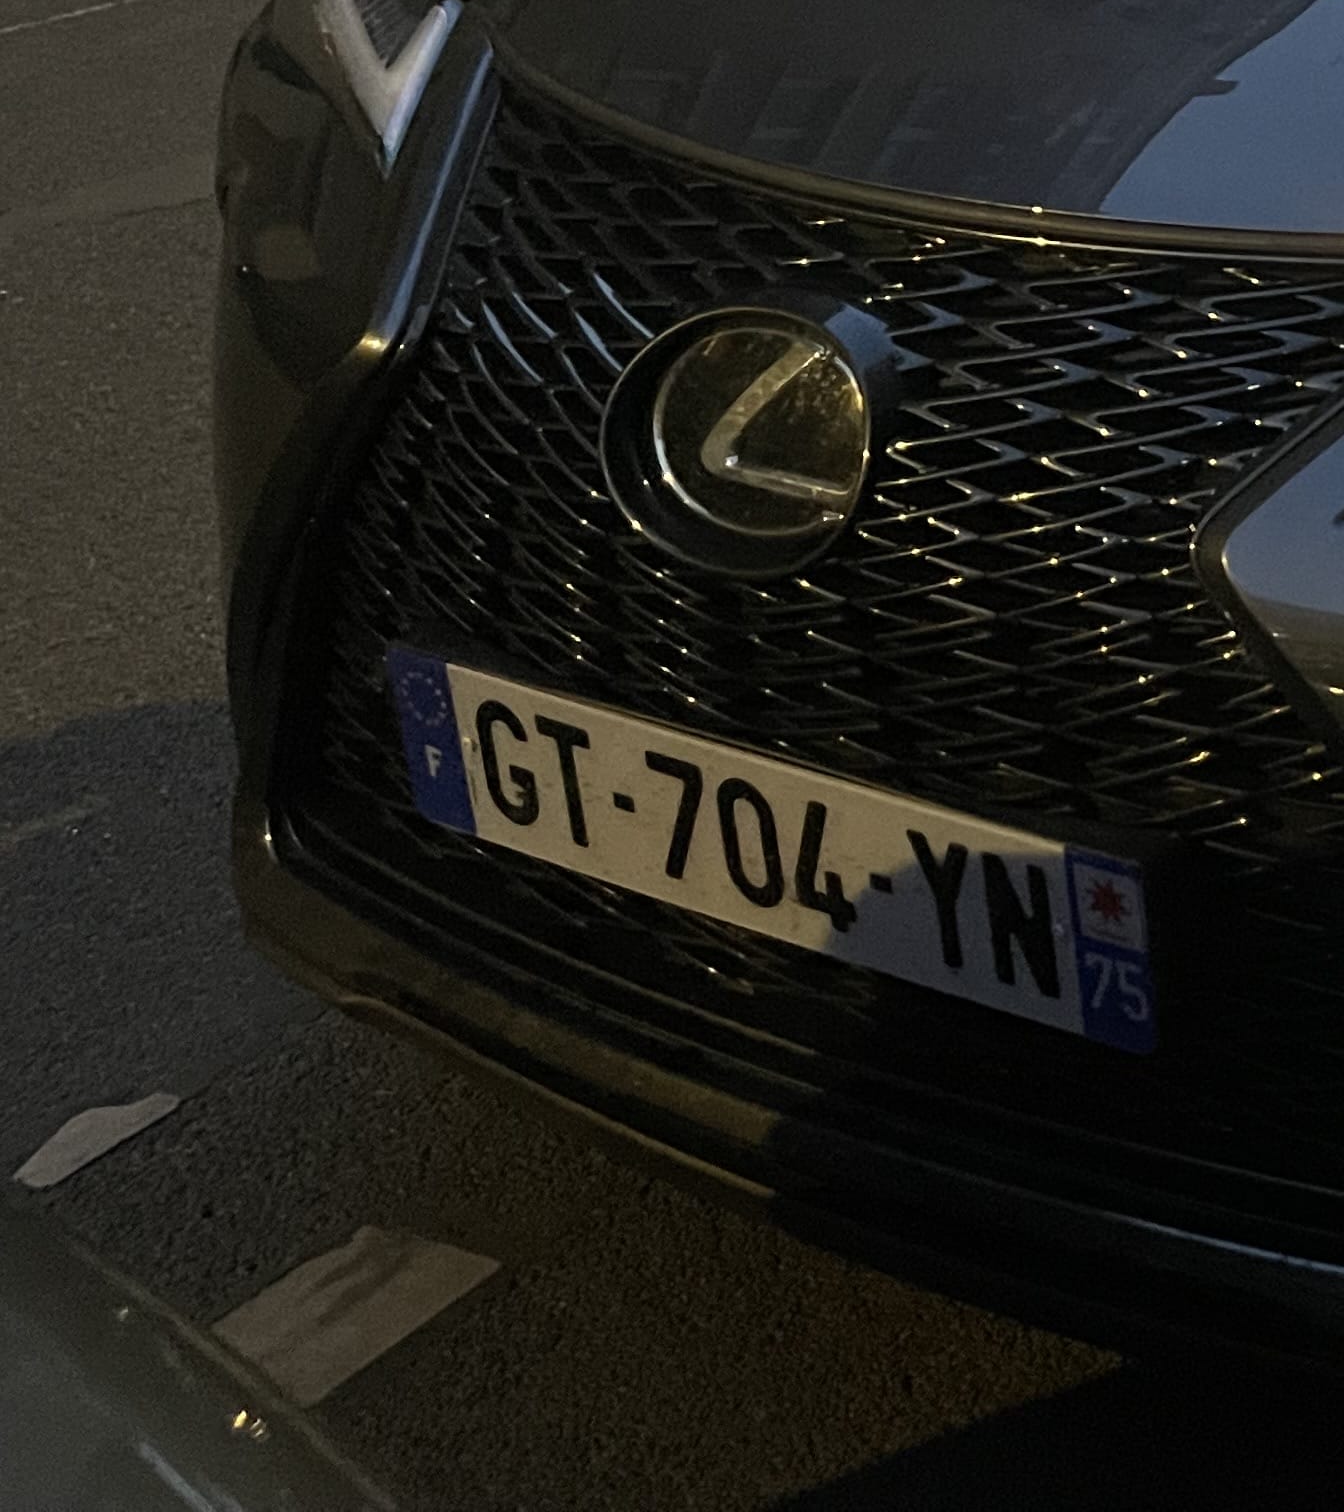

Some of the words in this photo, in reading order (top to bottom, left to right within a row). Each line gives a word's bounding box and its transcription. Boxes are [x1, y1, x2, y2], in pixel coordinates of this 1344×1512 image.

[424, 744, 442, 778] F
[475, 699, 1061, 999] GT-704-YN
[1083, 952, 1148, 1022] 75
